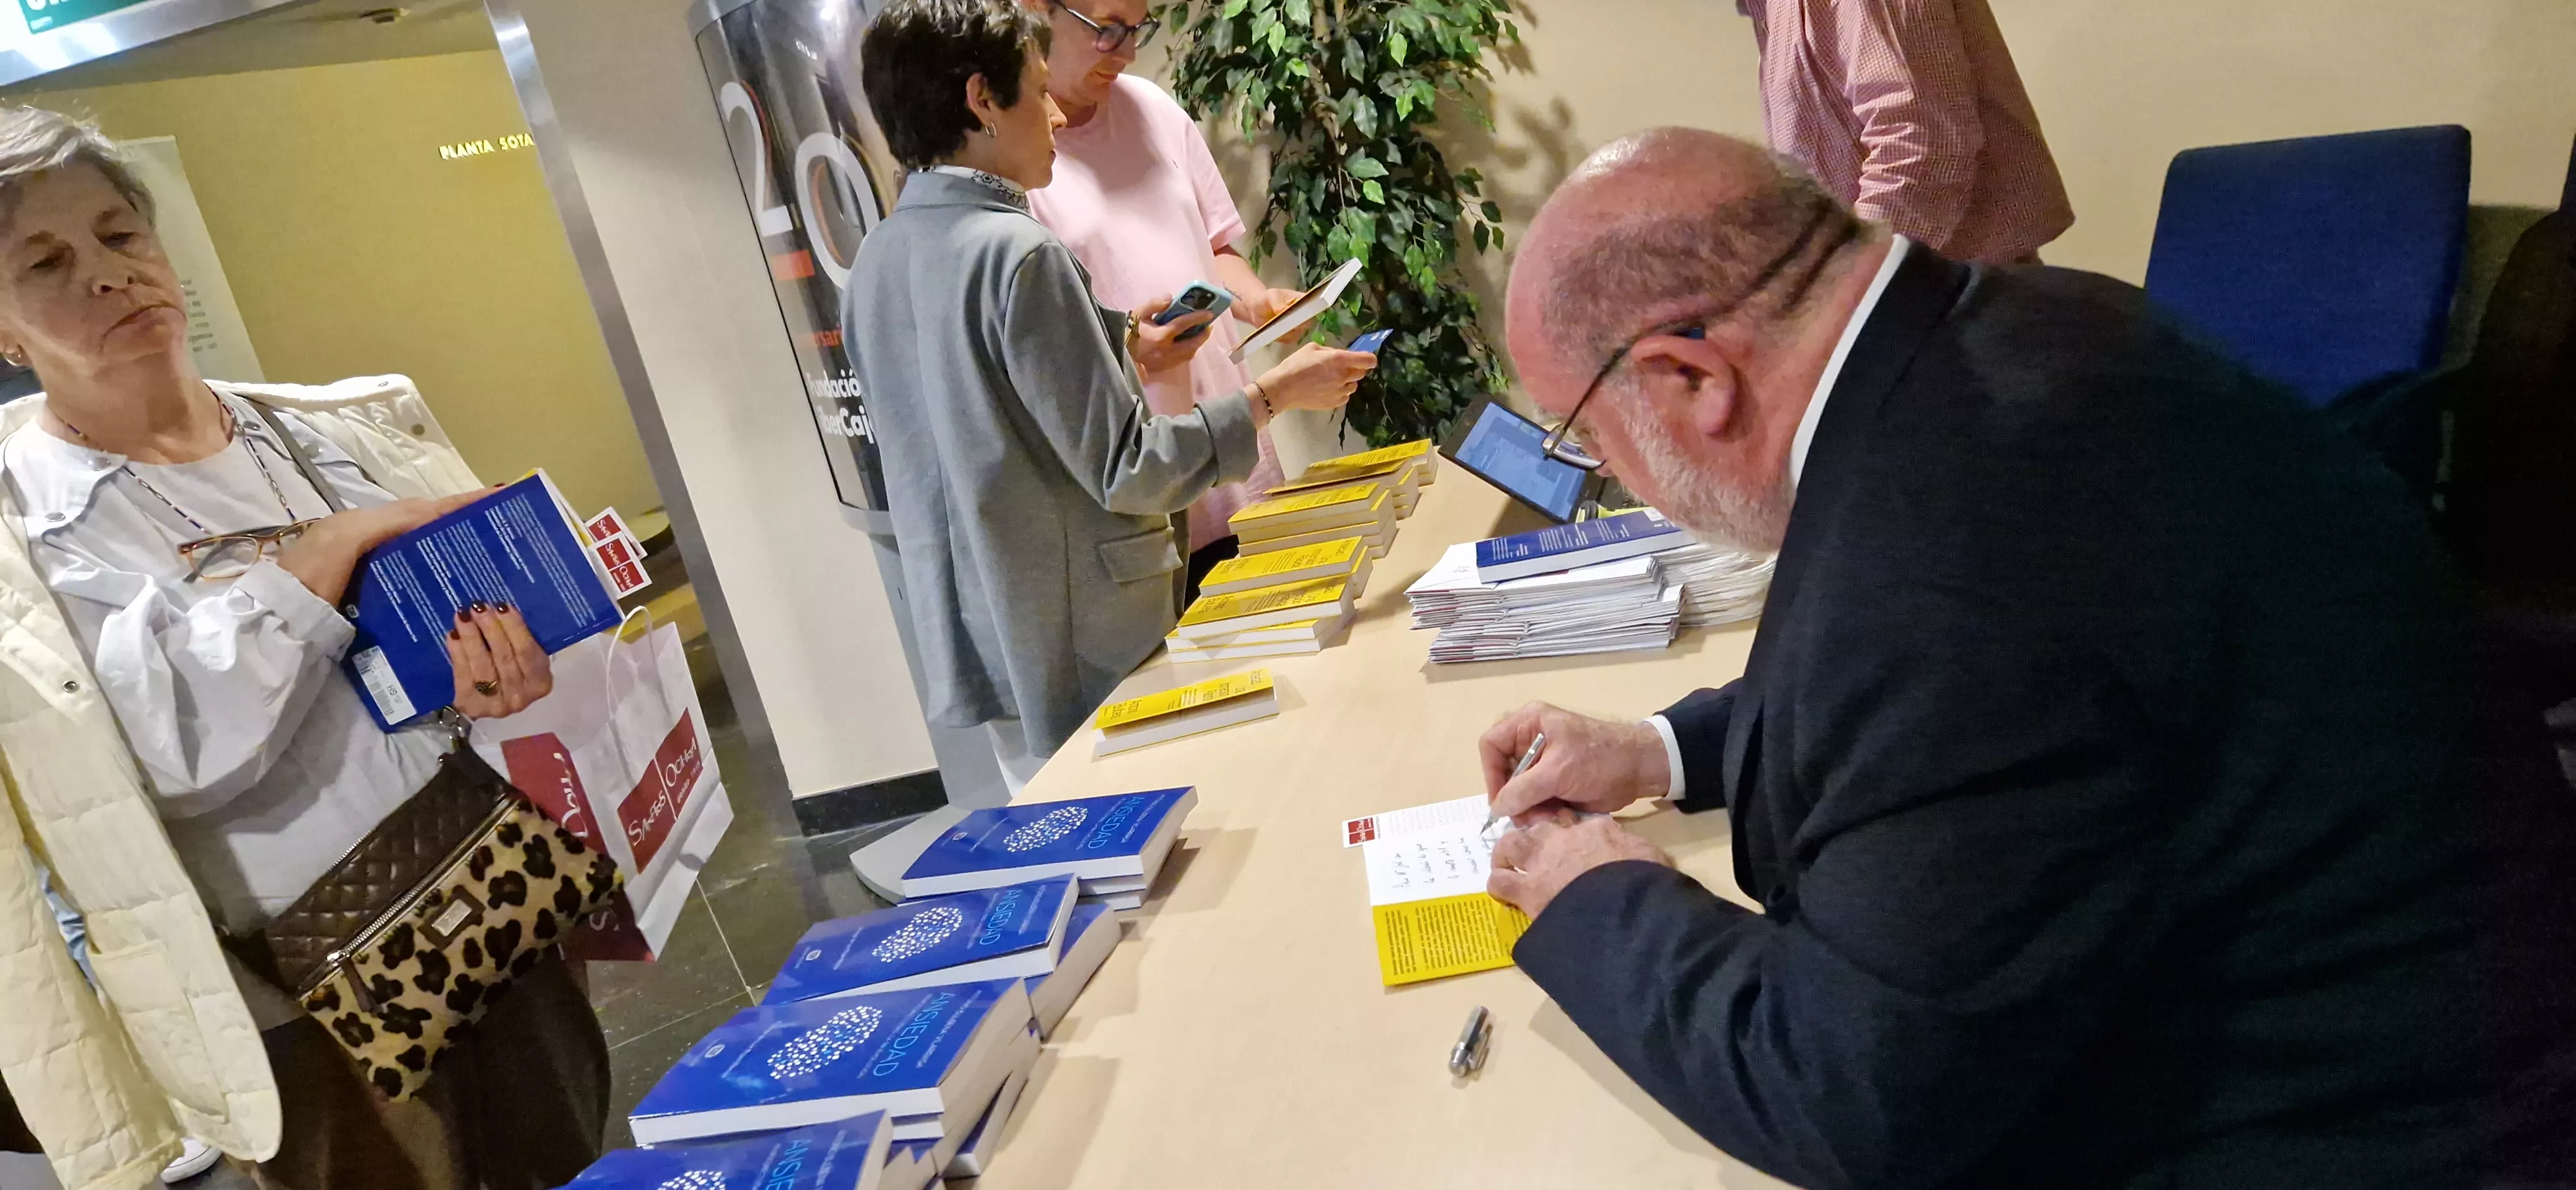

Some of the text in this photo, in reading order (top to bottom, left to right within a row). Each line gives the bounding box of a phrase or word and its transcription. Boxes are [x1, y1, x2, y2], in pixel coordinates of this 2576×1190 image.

[439, 133, 535, 160] PLANTA SOTA
[806, 368, 862, 399] Fundació
[1088, 796, 1144, 849] ANSIEDAD
[979, 889, 1023, 945] ANSIEDAD
[872, 992, 956, 1077] ANSIEDAD
[764, 1139, 812, 1190] ANSIE
